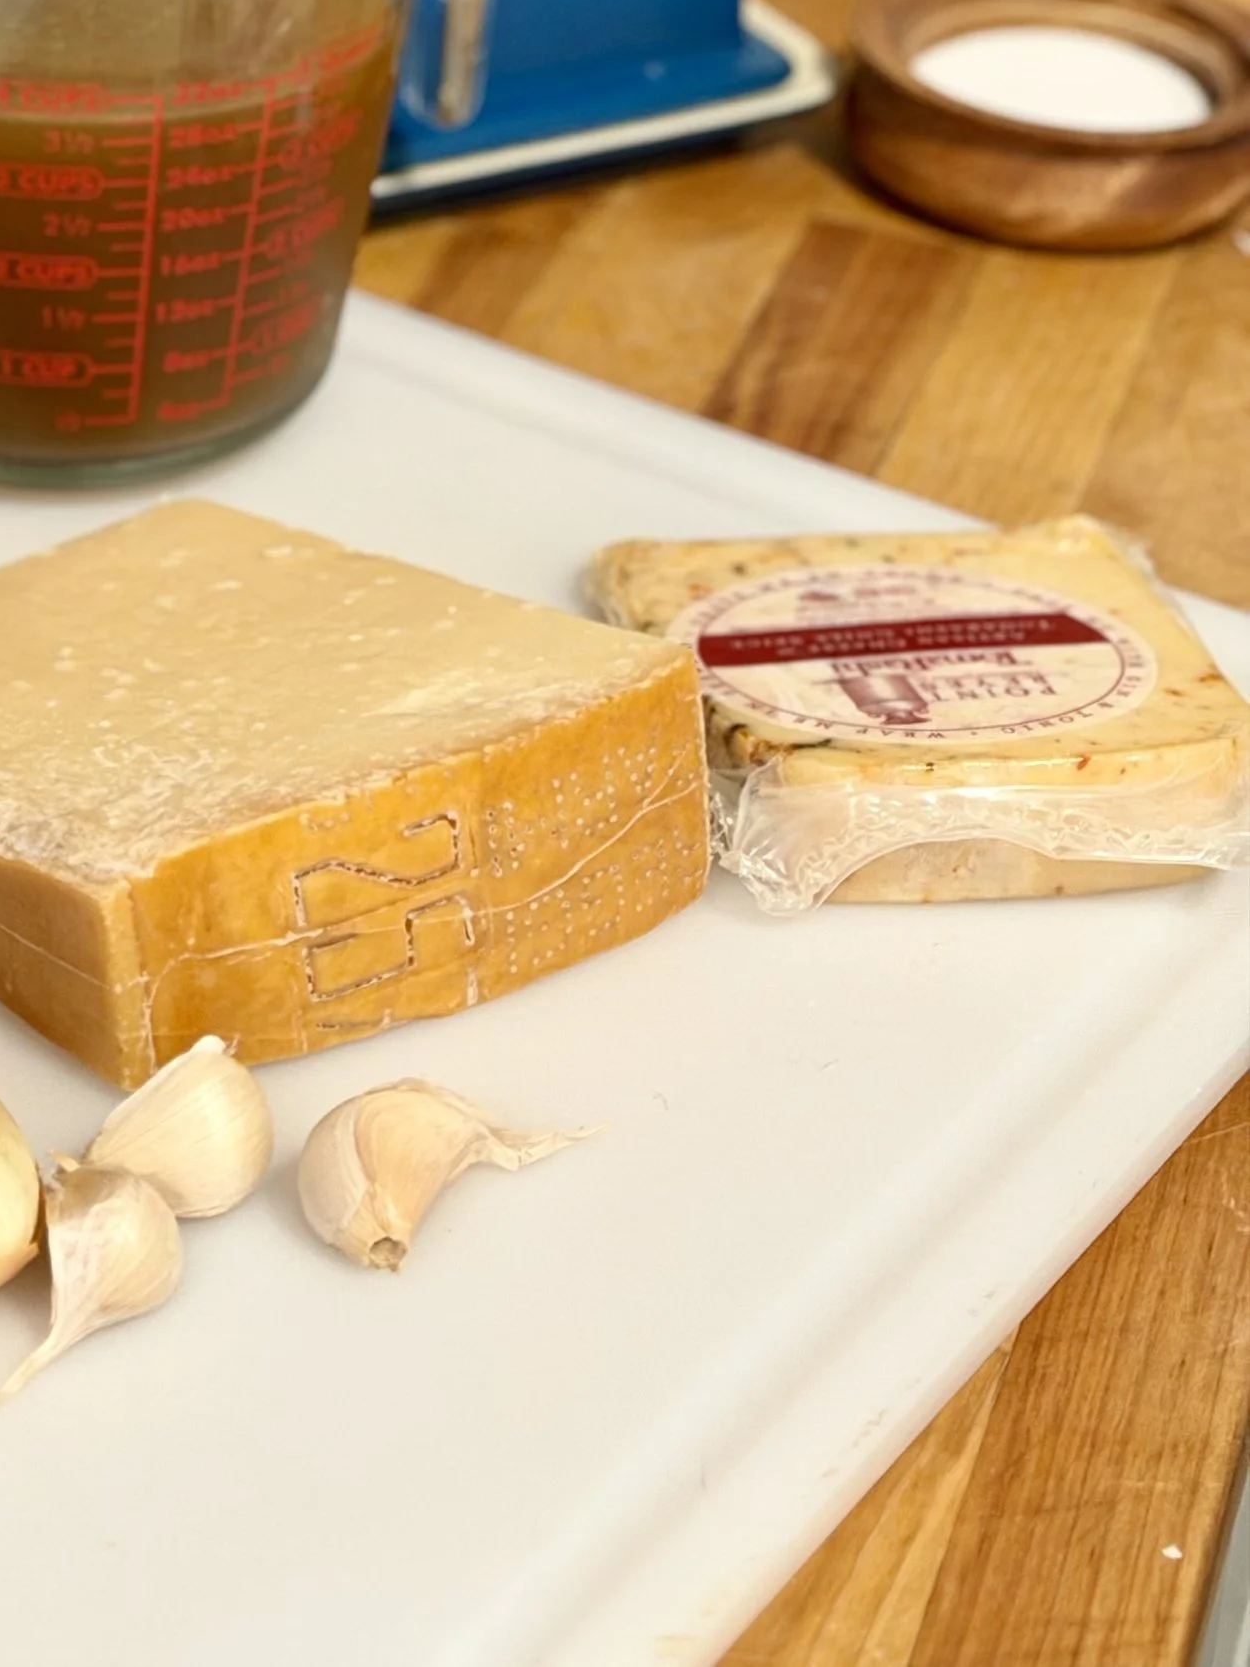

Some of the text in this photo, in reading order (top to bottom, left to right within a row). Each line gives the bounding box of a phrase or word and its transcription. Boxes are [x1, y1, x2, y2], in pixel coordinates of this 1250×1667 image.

[18, 171, 96, 194] CUPS
[21, 358, 77, 380] CUP
[926, 684, 1058, 703] POINT
[1000, 708, 1094, 735] TONIC
[856, 728, 945, 739] WRAP
